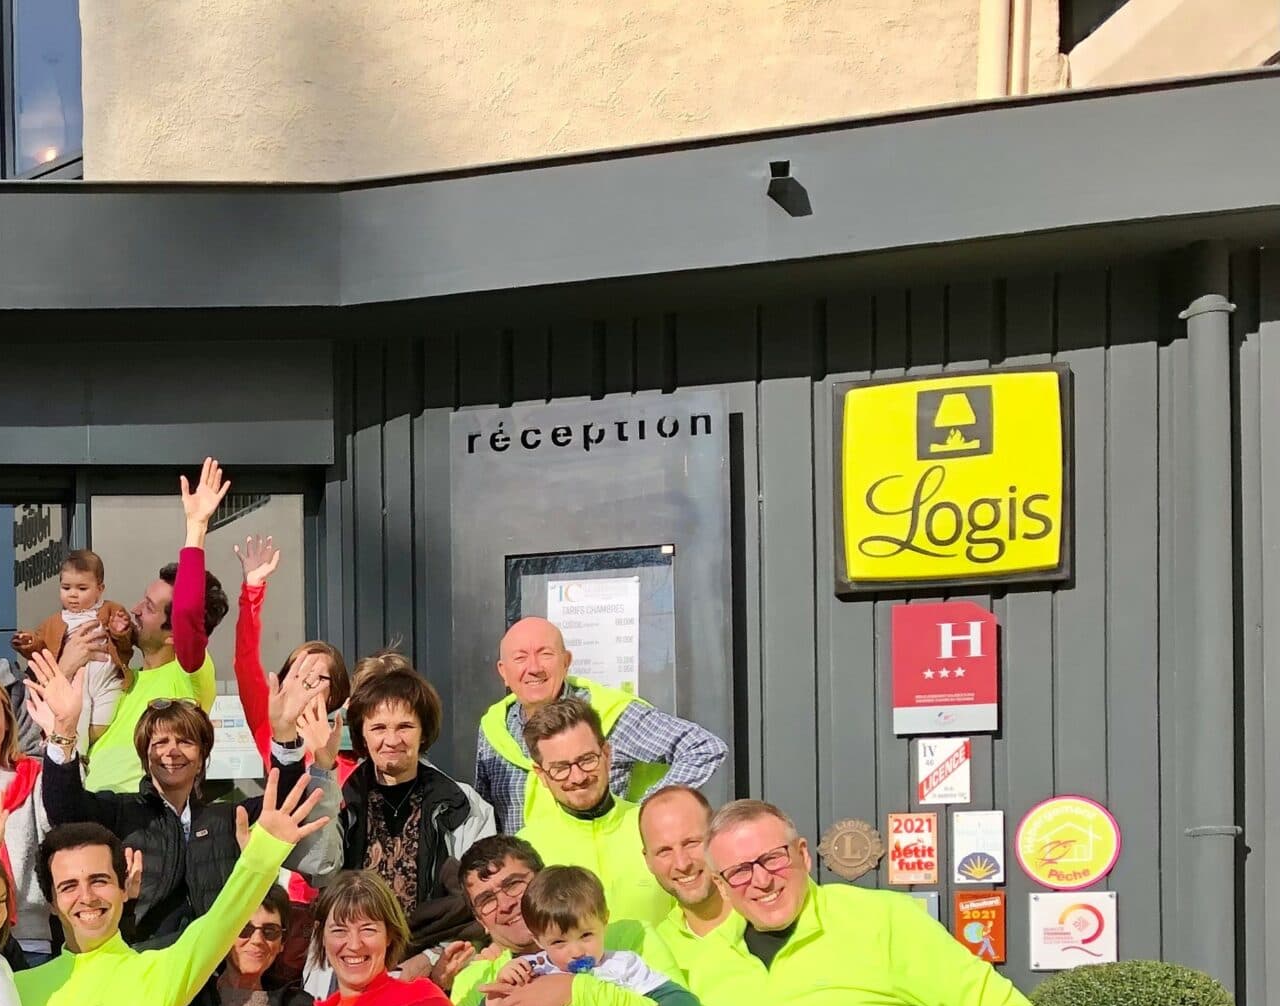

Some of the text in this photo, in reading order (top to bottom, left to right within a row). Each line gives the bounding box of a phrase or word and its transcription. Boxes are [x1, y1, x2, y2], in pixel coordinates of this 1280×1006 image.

[467, 412, 712, 454] réception
[858, 464, 1053, 564] Logis
[935, 620, 987, 659] H
[923, 744, 966, 799] LICENCE
[893, 817, 932, 833] 2021
[962, 909, 996, 920] 2021
